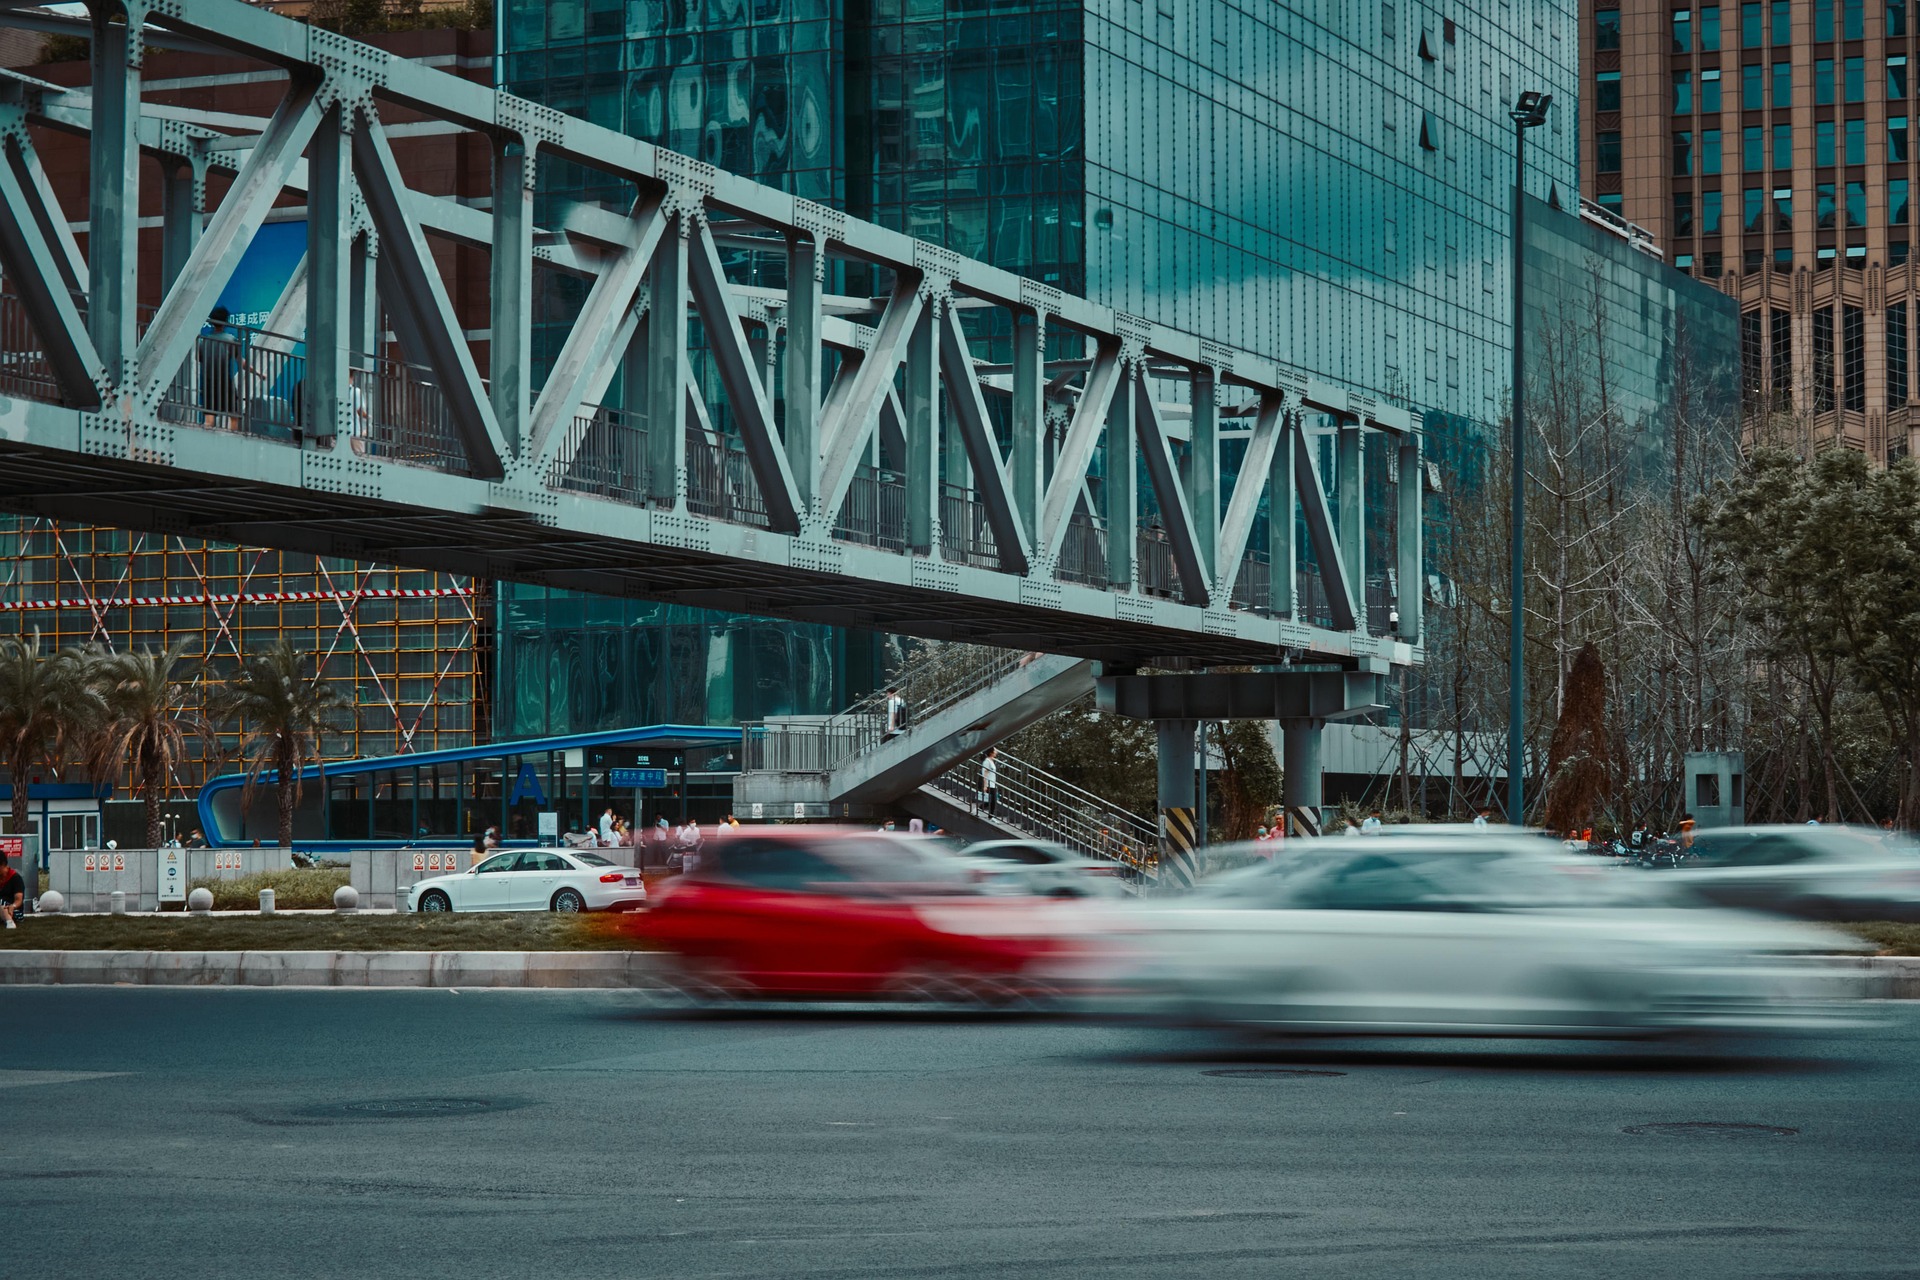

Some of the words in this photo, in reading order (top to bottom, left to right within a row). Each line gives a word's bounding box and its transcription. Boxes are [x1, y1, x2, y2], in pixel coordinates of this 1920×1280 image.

[510, 763, 546, 805] A
[613, 770, 662, 780] 天府大道中段
